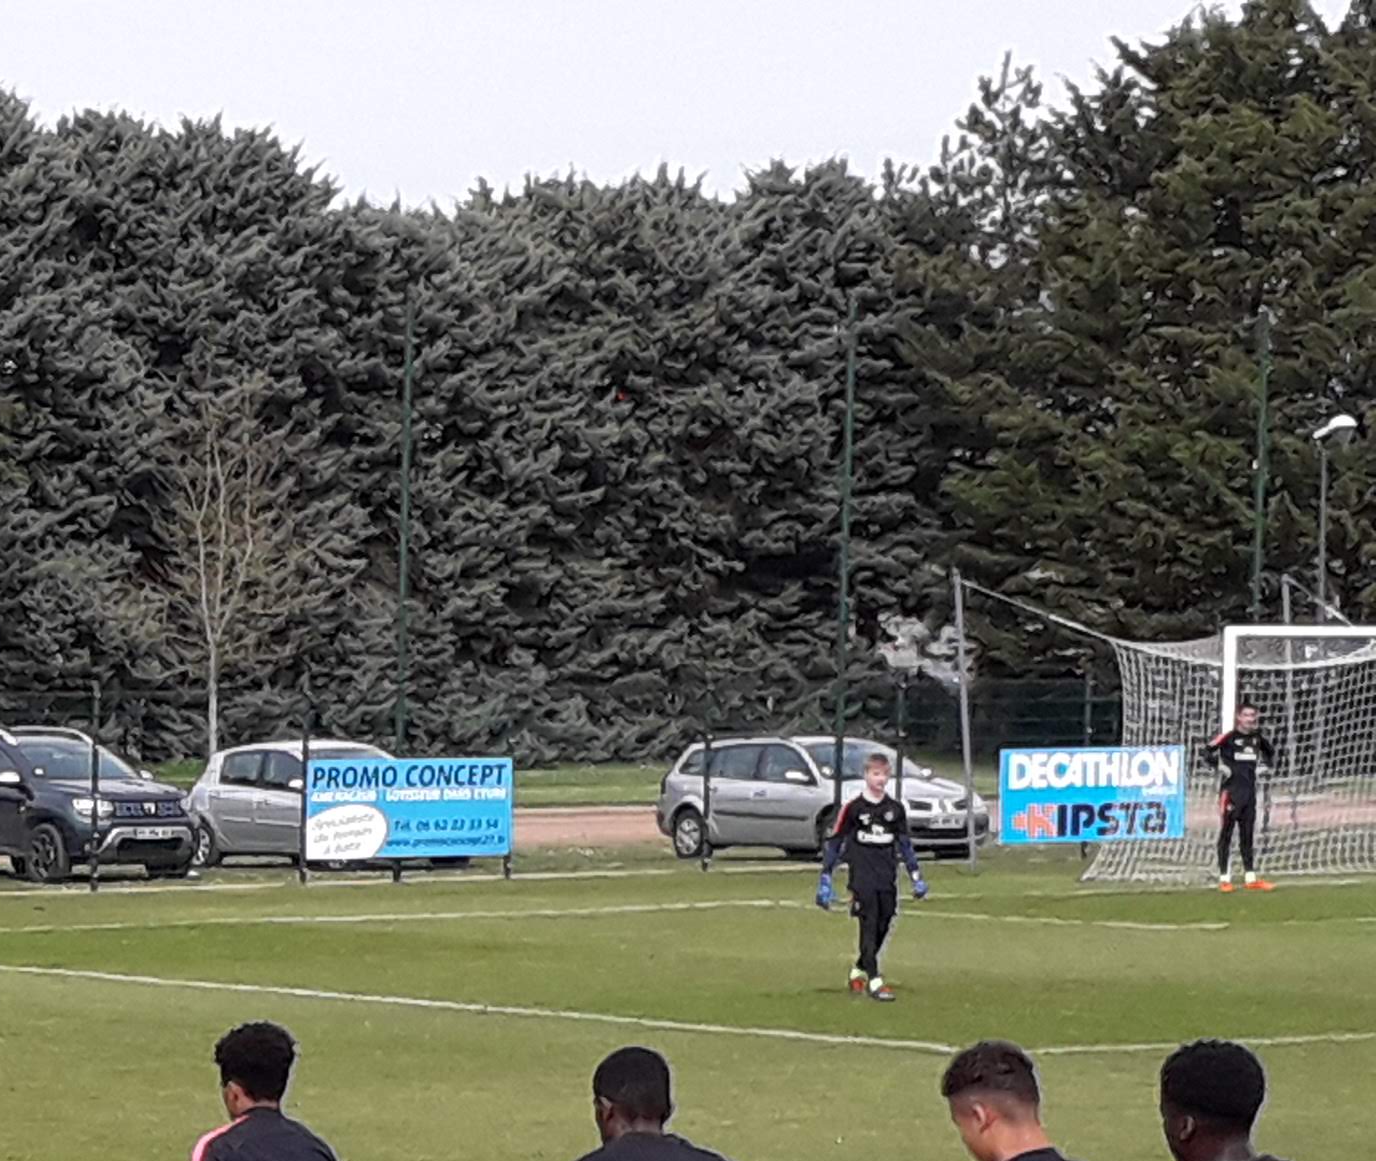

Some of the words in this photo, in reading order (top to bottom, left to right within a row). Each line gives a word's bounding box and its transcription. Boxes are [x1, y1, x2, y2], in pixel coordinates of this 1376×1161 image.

[312, 766, 398, 789] PROMO
[405, 764, 506, 787] CONCEPT
[1008, 751, 1179, 790] DECATHLON
